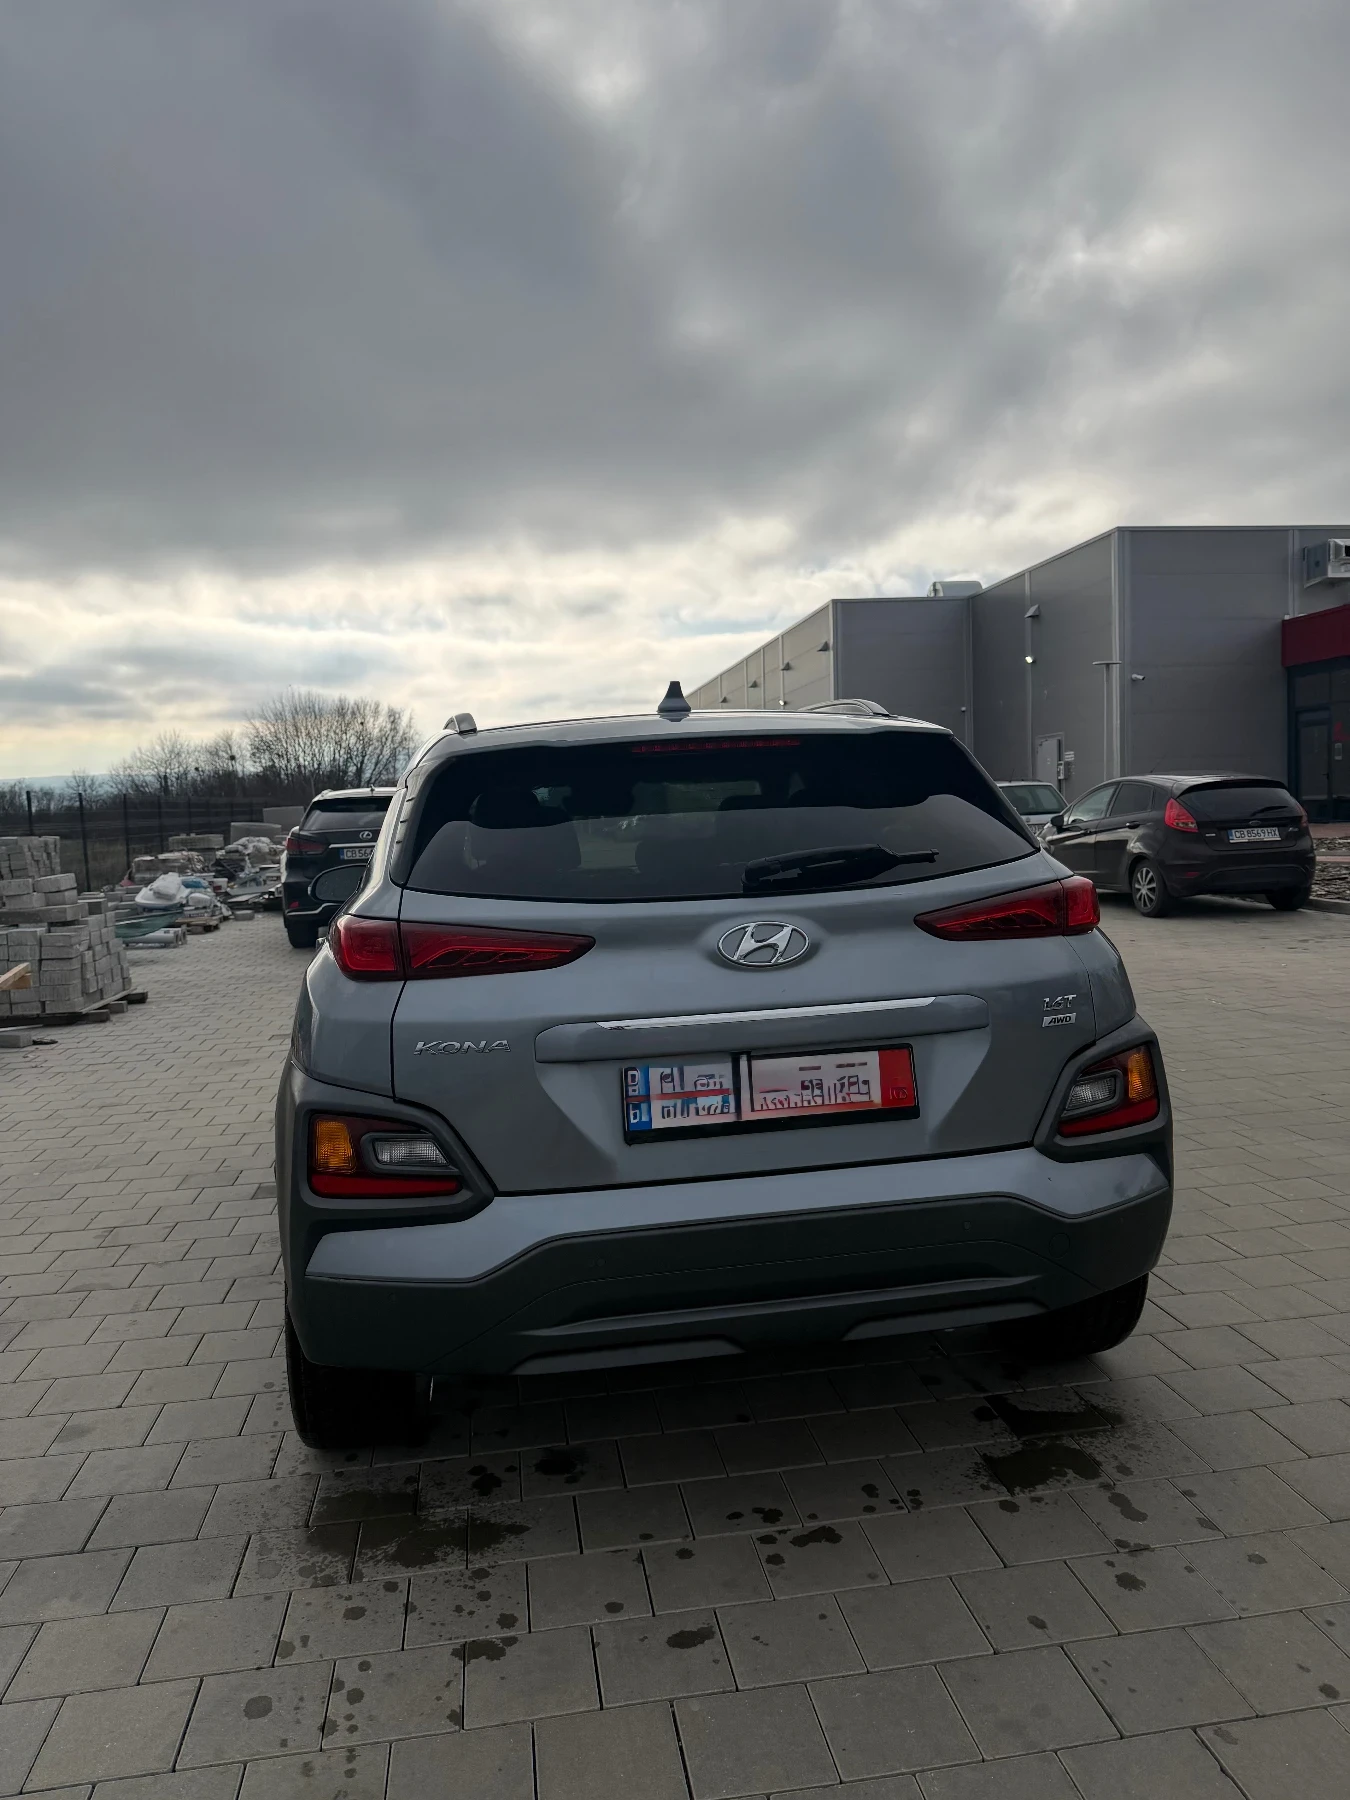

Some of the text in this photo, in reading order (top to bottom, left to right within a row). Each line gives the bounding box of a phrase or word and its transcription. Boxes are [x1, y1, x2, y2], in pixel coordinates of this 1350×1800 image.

[345, 849, 357, 858] CB
[1048, 1015, 1072, 1025] AWD
[413, 1039, 511, 1056] KONA
